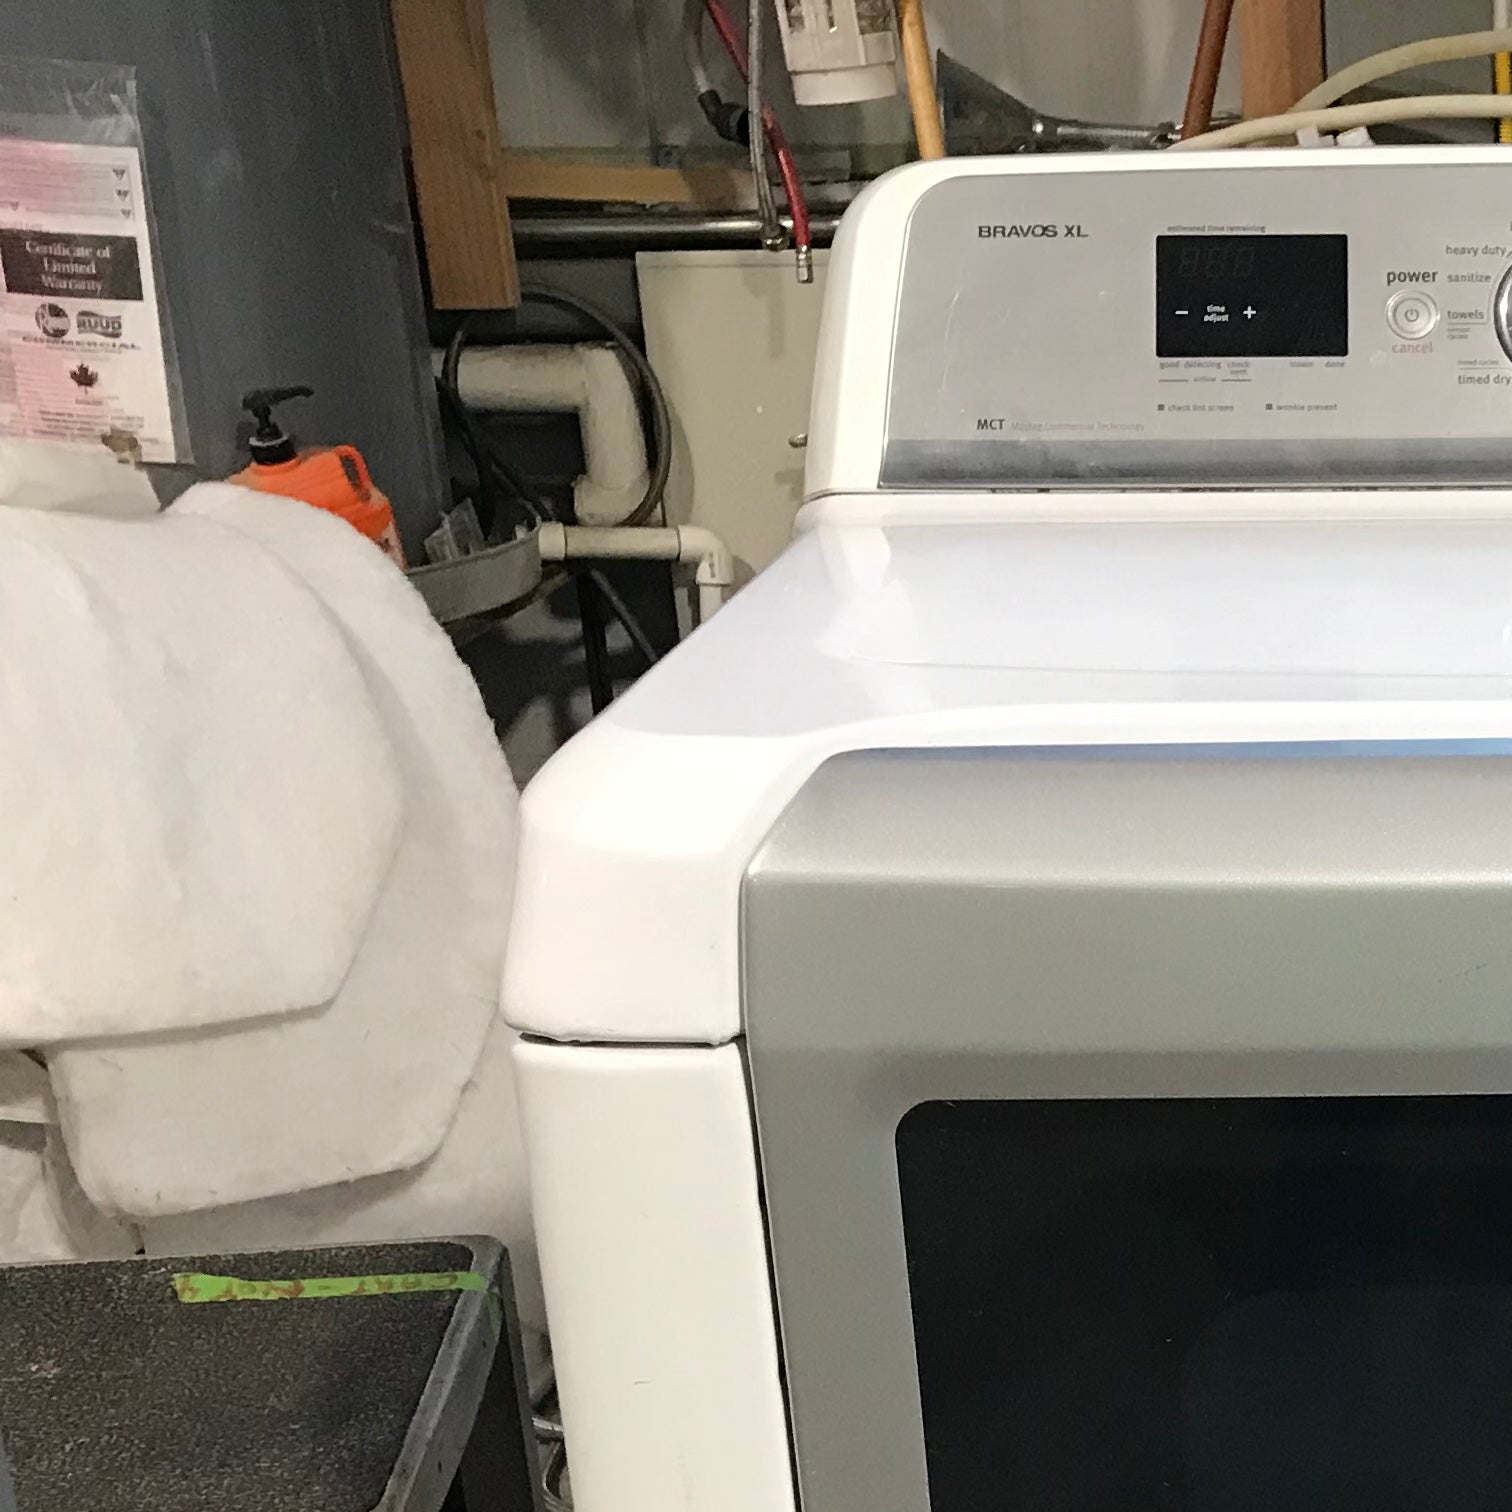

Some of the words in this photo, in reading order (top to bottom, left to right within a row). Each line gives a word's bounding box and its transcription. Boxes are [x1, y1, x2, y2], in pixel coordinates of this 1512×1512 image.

[978, 224, 1058, 238] BRAVOS
[1064, 224, 1089, 238] XL
[1445, 245, 1480, 257] heavy
[1481, 245, 1507, 256] duty
[43, 256, 96, 274] Limited
[1387, 270, 1438, 286] power
[1447, 272, 1491, 283] sanitize
[1207, 304, 1226, 313] time
[1447, 309, 1485, 320] towels
[1203, 314, 1229, 323] adjust
[1392, 341, 1433, 353] cancel
[1458, 374, 1491, 385] timed
[1493, 374, 1512, 386] dry
[977, 418, 1005, 431] MCT
